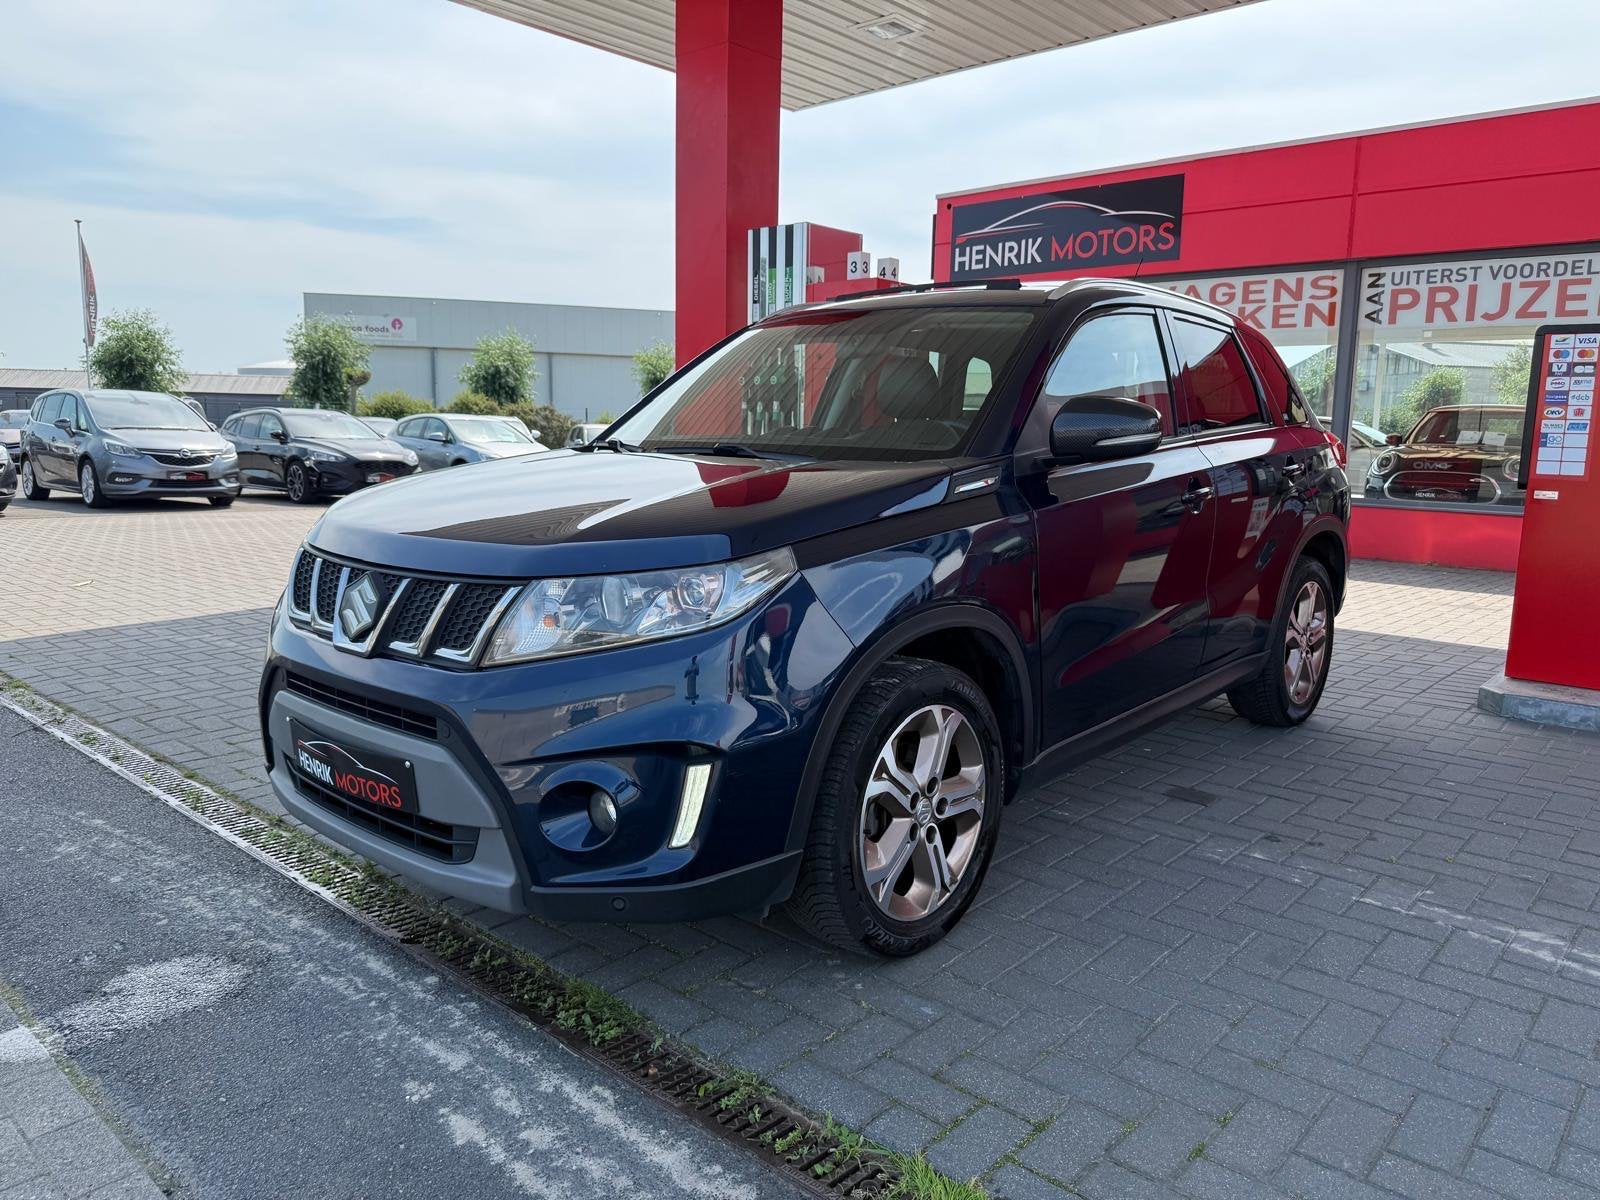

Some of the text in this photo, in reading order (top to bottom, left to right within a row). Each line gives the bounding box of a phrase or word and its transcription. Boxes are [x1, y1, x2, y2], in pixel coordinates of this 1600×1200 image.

[954, 221, 1175, 272] HENRIK MOTORS
[850, 260, 857, 274] 3
[862, 261, 869, 274] 3
[879, 266, 886, 278] 4
[891, 266, 897, 278] 4
[1390, 258, 1600, 287] UITERST VOORDEL
[1168, 275, 1338, 306] AGENS
[1364, 271, 1387, 325] AAN
[1387, 277, 1600, 325] PRIJZE
[364, 324, 389, 333] foods
[1237, 301, 1337, 330] KEN
[1577, 337, 1598, 345] VISA
[298, 749, 402, 809] HENRIK MOTORS
